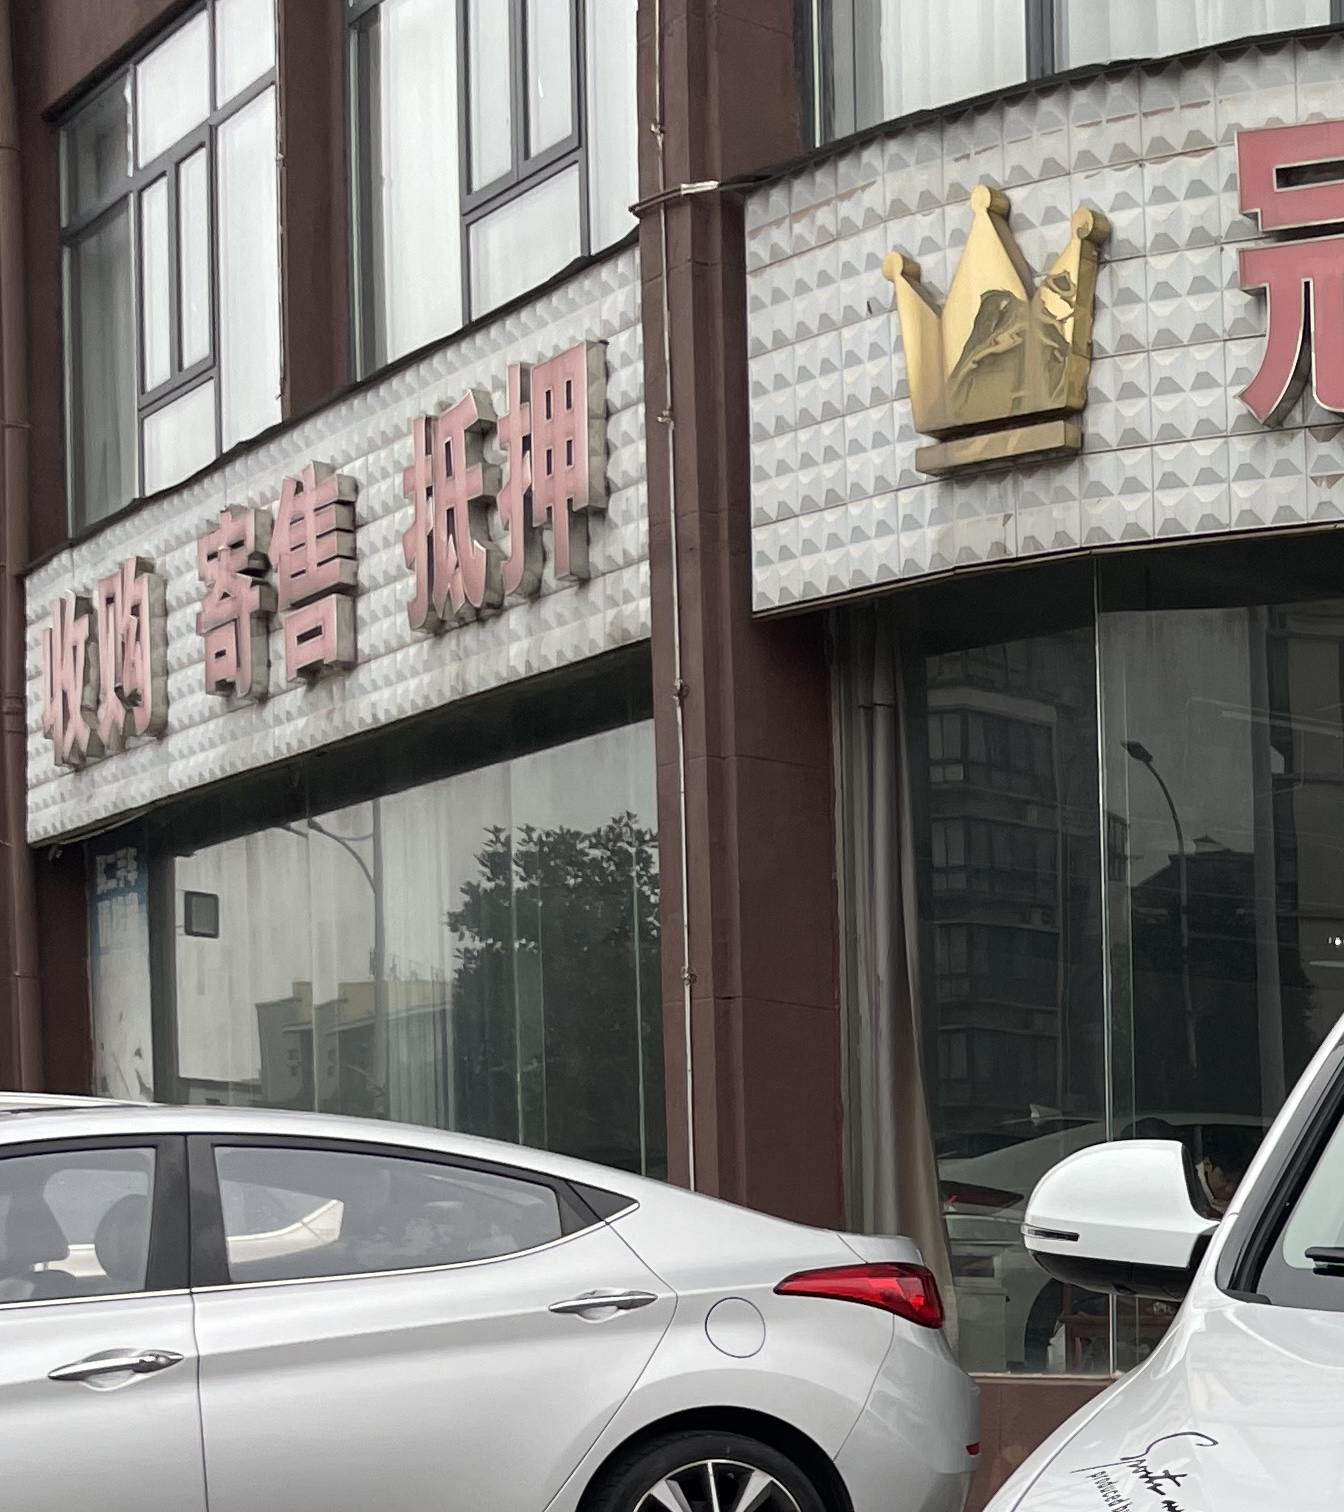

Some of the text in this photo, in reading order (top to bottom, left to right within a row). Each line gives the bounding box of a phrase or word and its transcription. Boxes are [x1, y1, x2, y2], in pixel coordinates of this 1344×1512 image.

[42, 340, 607, 768] 收购 寄售 抵押
